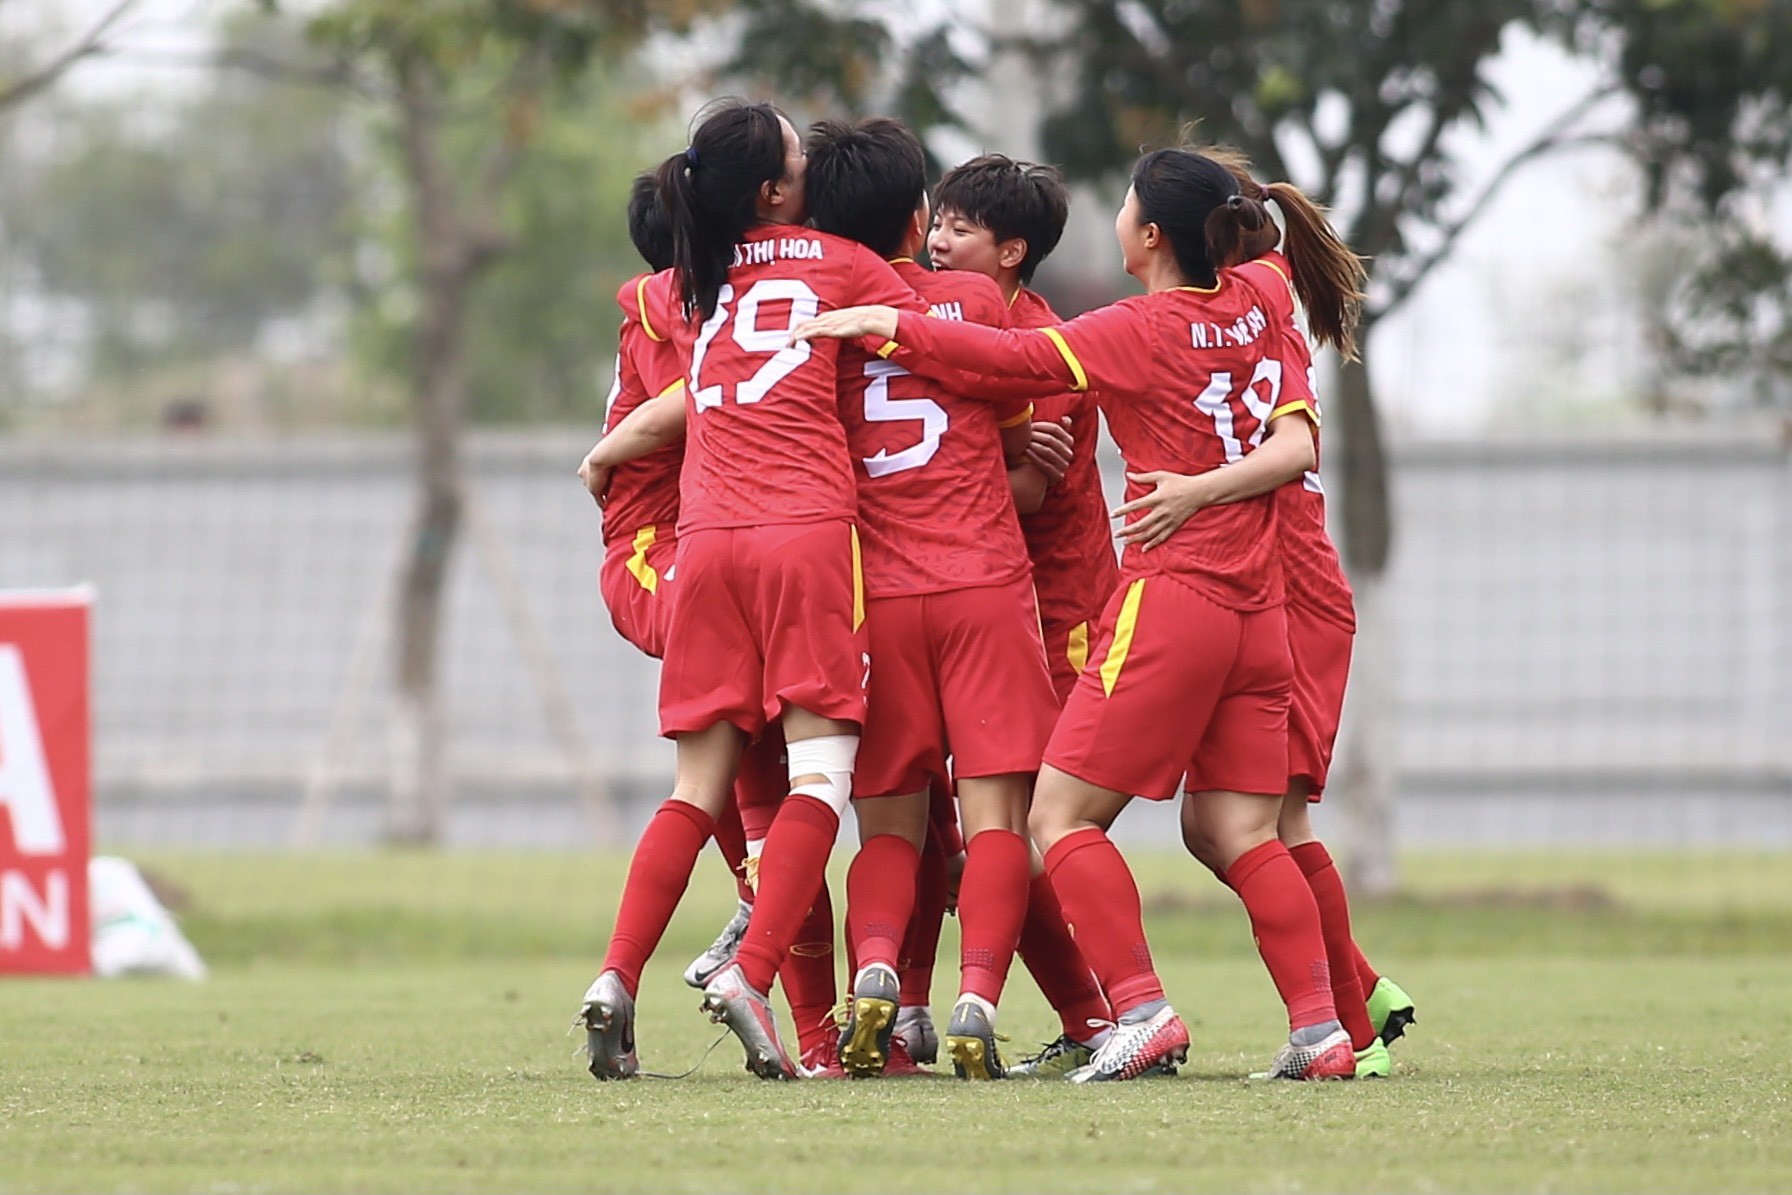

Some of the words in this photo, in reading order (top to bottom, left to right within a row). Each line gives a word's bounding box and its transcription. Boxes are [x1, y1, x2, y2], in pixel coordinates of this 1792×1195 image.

[780, 238, 823, 260] HOA
[863, 360, 949, 478] 5
[1193, 356, 1282, 467] 19
